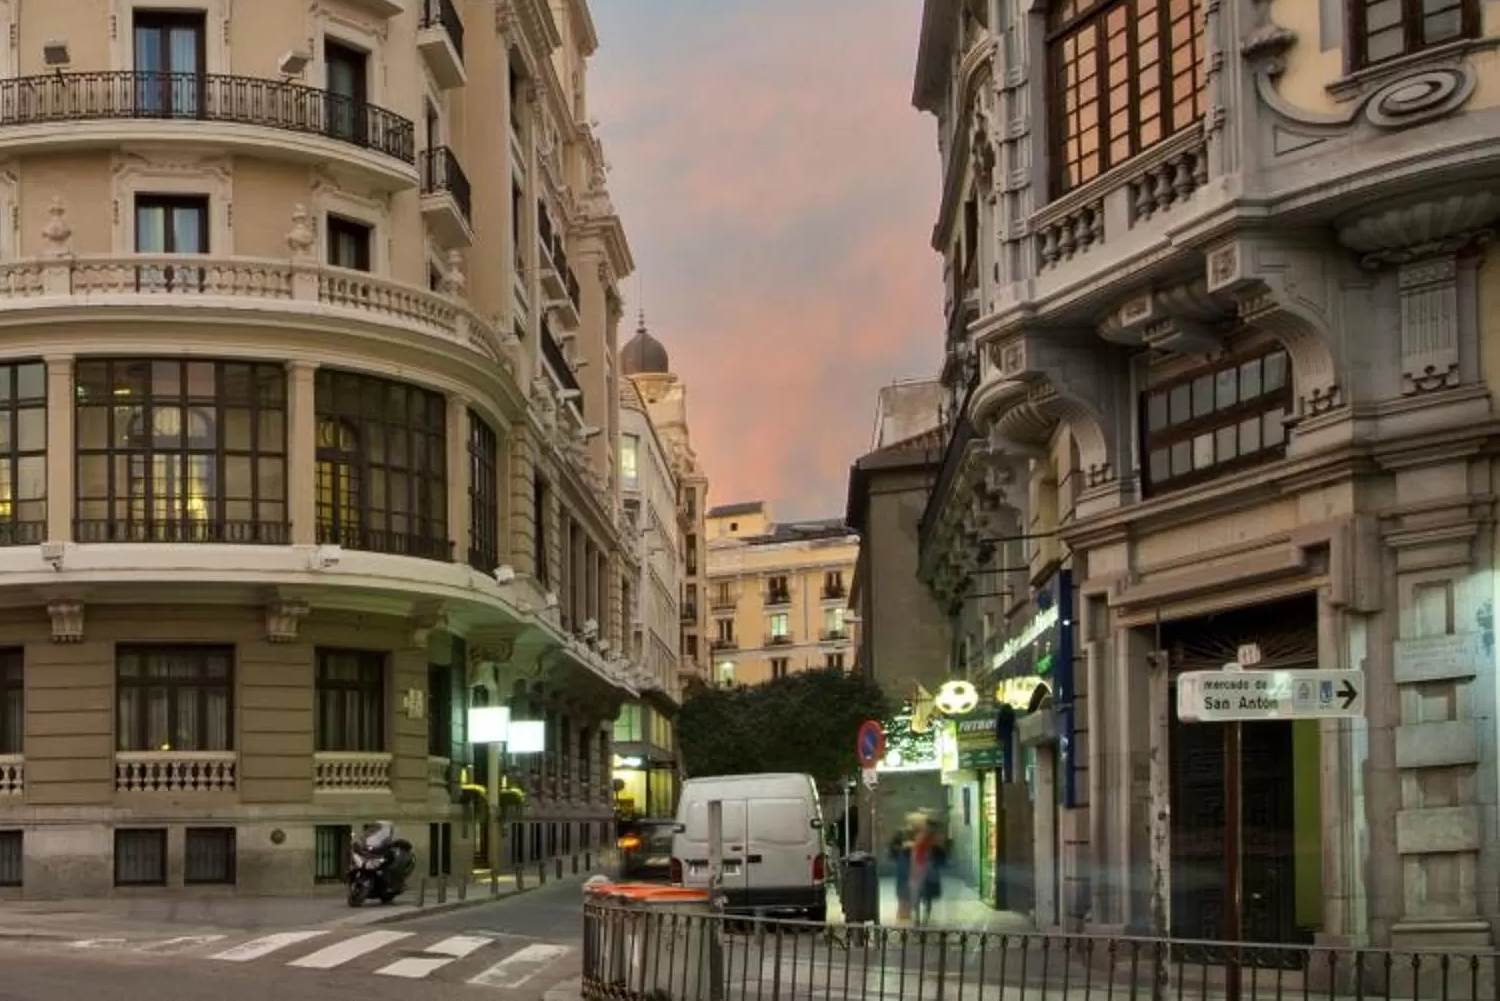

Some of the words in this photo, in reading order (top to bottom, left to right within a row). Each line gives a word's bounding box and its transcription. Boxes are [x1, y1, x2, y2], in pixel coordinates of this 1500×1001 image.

[1204, 679, 1249, 689] mercado
[1255, 679, 1267, 689] de
[1204, 696, 1230, 710] San
